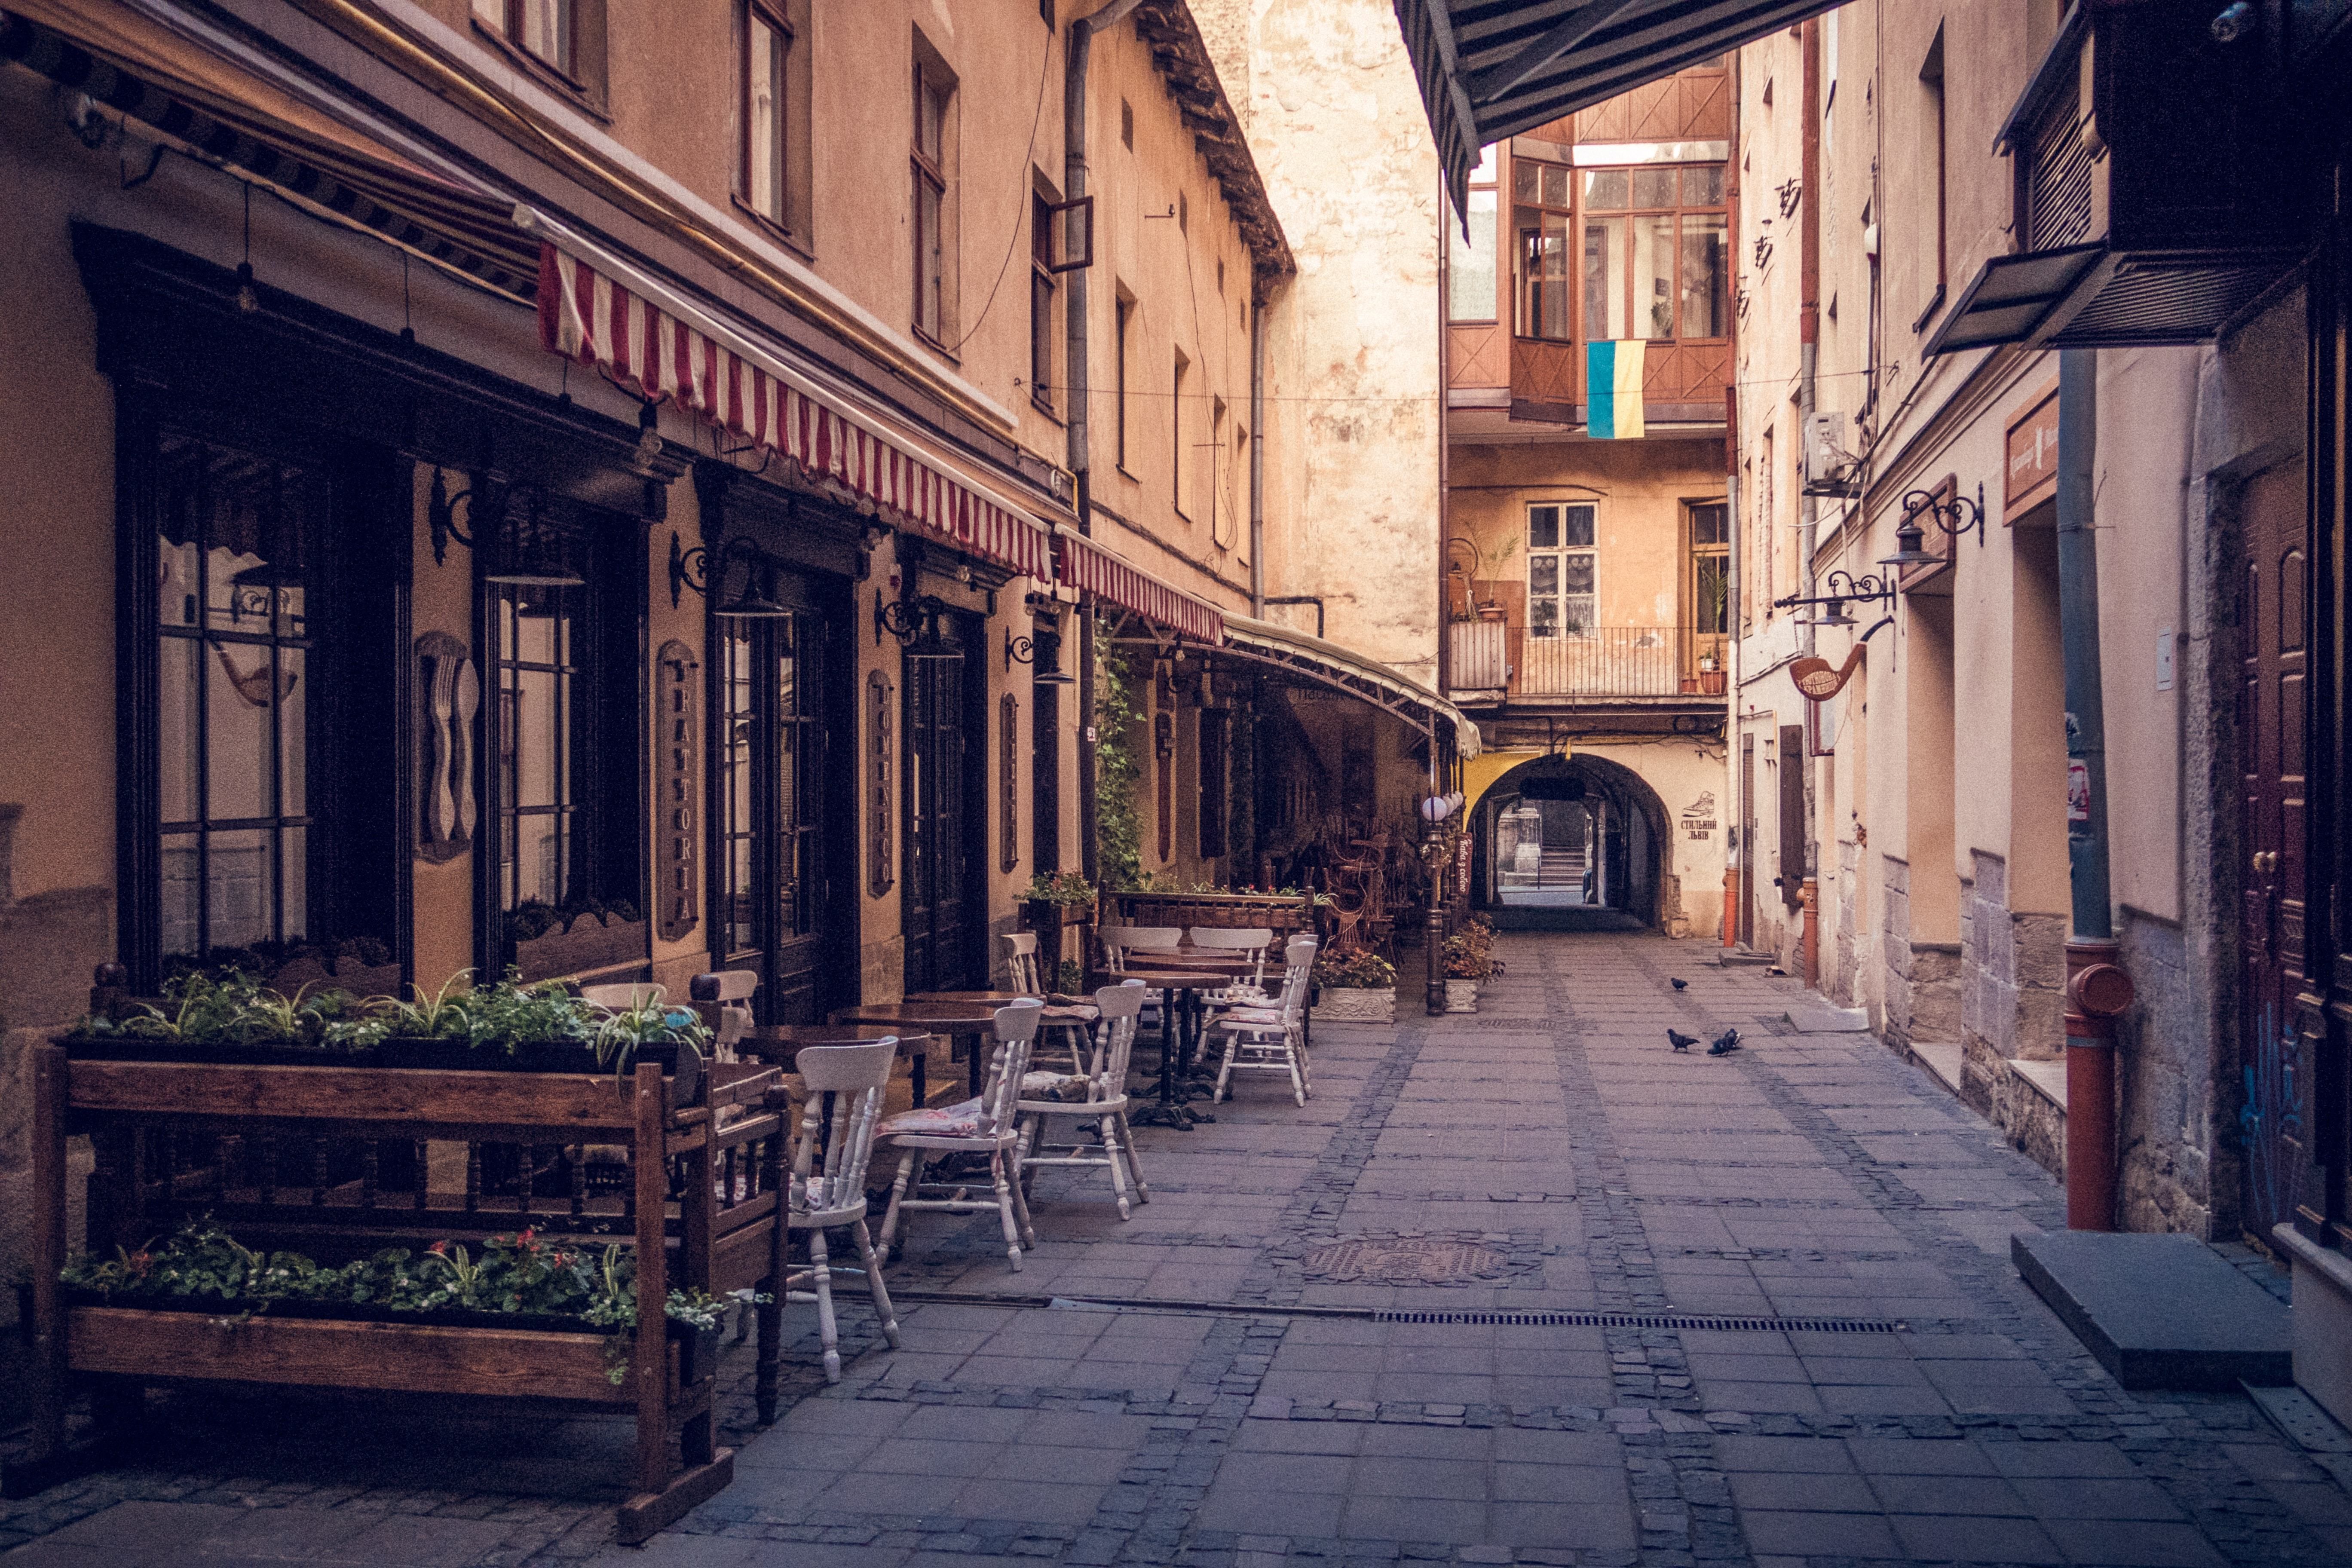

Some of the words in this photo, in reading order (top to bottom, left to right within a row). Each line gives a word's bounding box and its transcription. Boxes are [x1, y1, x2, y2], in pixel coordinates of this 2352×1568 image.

[681, 660, 690, 920] TRATTORIA
[1681, 818, 1717, 830] СТИЛЬНИЙ
[1688, 830, 1709, 840] ЛЬВІВ
[1460, 839, 1471, 860] Кава
[1460, 868, 1468, 893] собою
